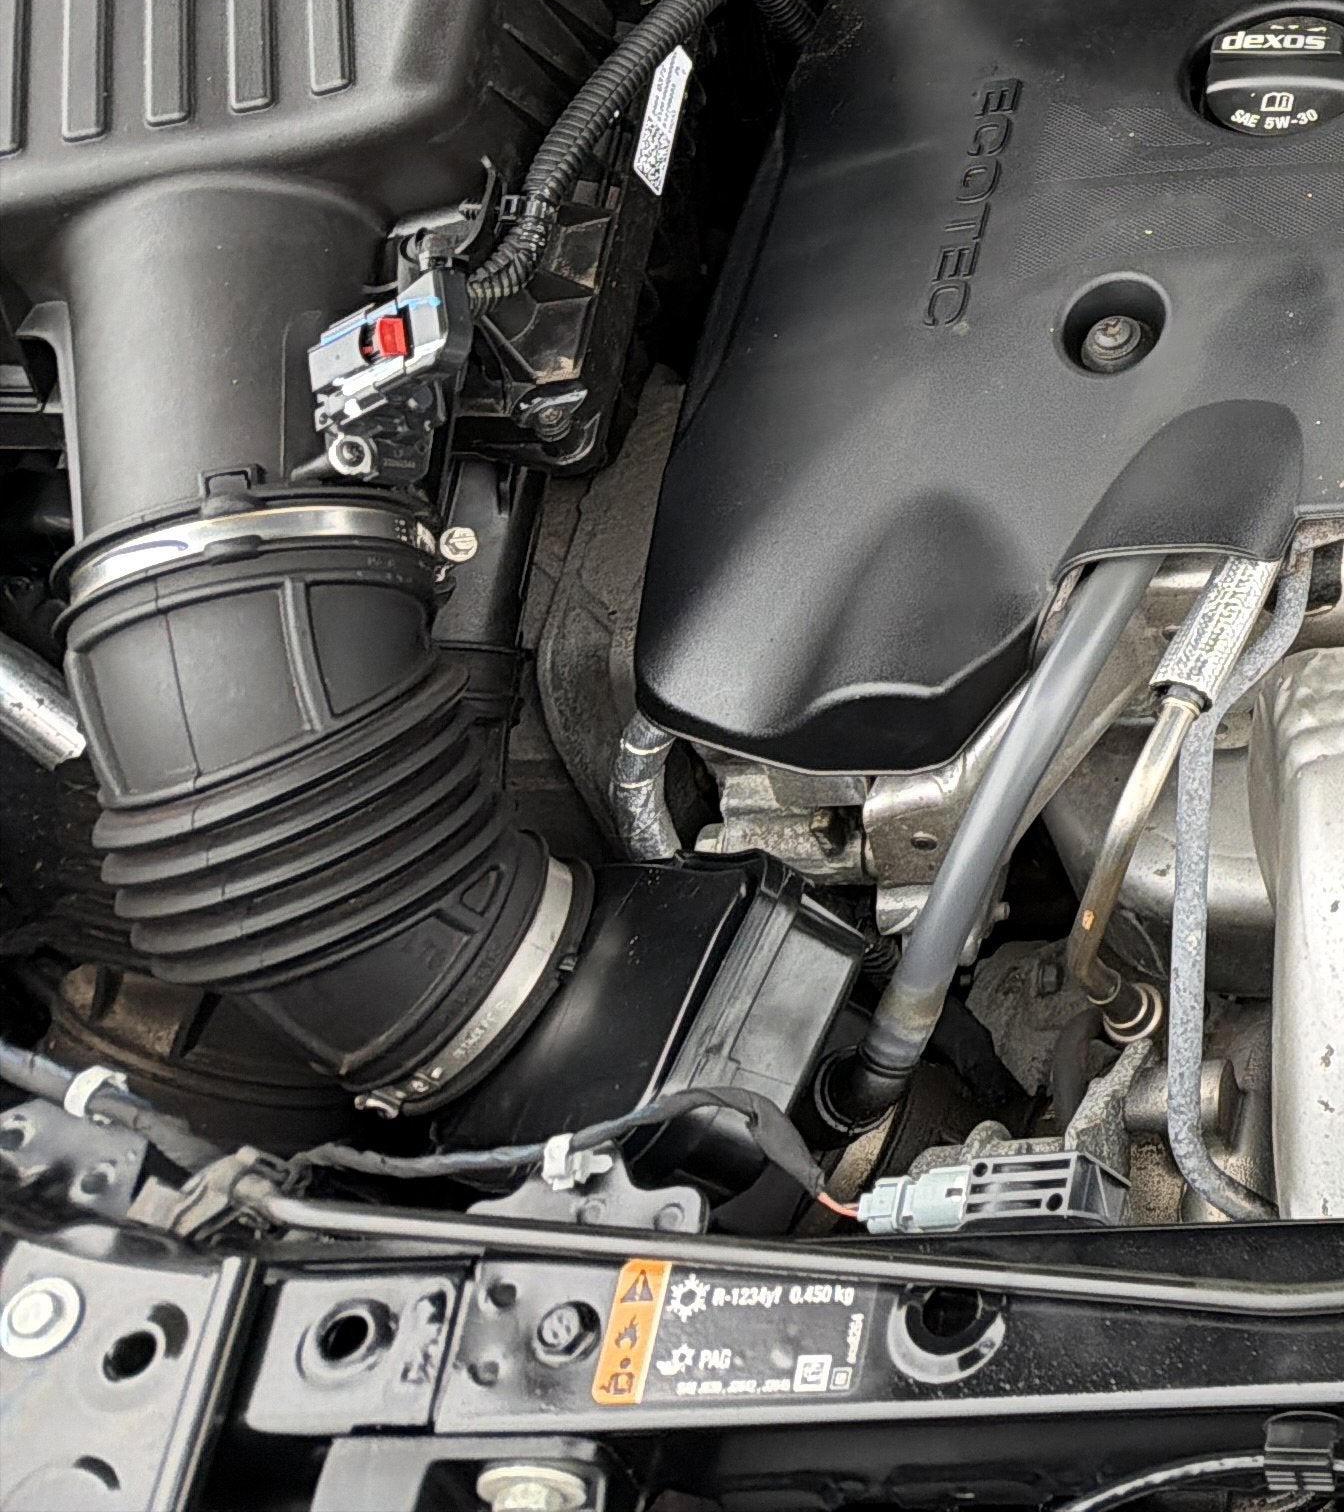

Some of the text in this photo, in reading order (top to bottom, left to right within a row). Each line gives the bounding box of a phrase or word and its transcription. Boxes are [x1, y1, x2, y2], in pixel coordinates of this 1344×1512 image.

[1221, 31, 1328, 50] dexos
[1231, 109, 1318, 130] SAE 5W-30
[923, 77, 1024, 327] ECOTEC
[712, 1285, 856, 1308] R-1234yf 0.450 kg
[699, 1349, 732, 1370] PAG
